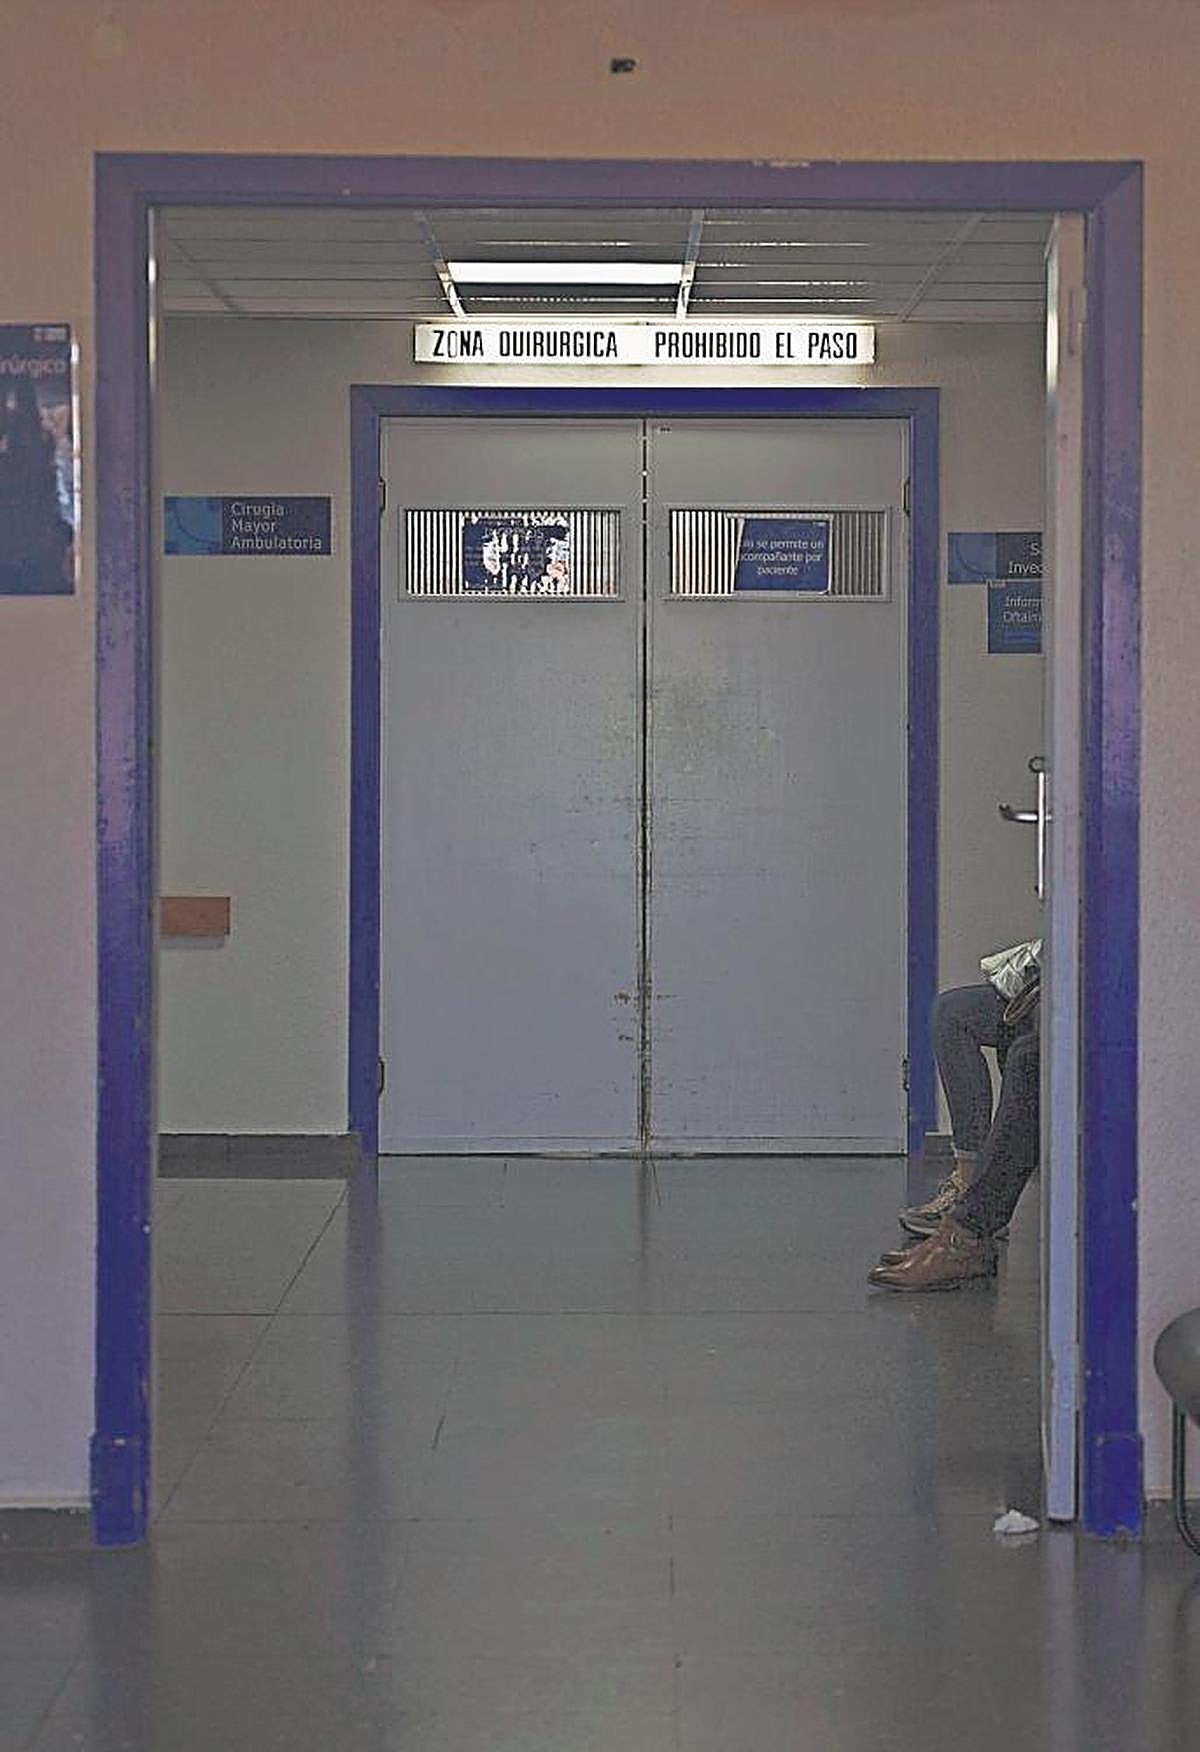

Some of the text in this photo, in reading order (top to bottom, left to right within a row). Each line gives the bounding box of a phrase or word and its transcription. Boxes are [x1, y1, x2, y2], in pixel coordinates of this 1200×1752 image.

[432, 331, 484, 358] ZONA
[655, 331, 762, 358] PROHIBIDO
[774, 332, 795, 359] EL
[807, 332, 858, 359] PASO
[231, 518, 277, 535] Mayor
[230, 535, 322, 550] Ambulatoria
[805, 552, 822, 564] por
